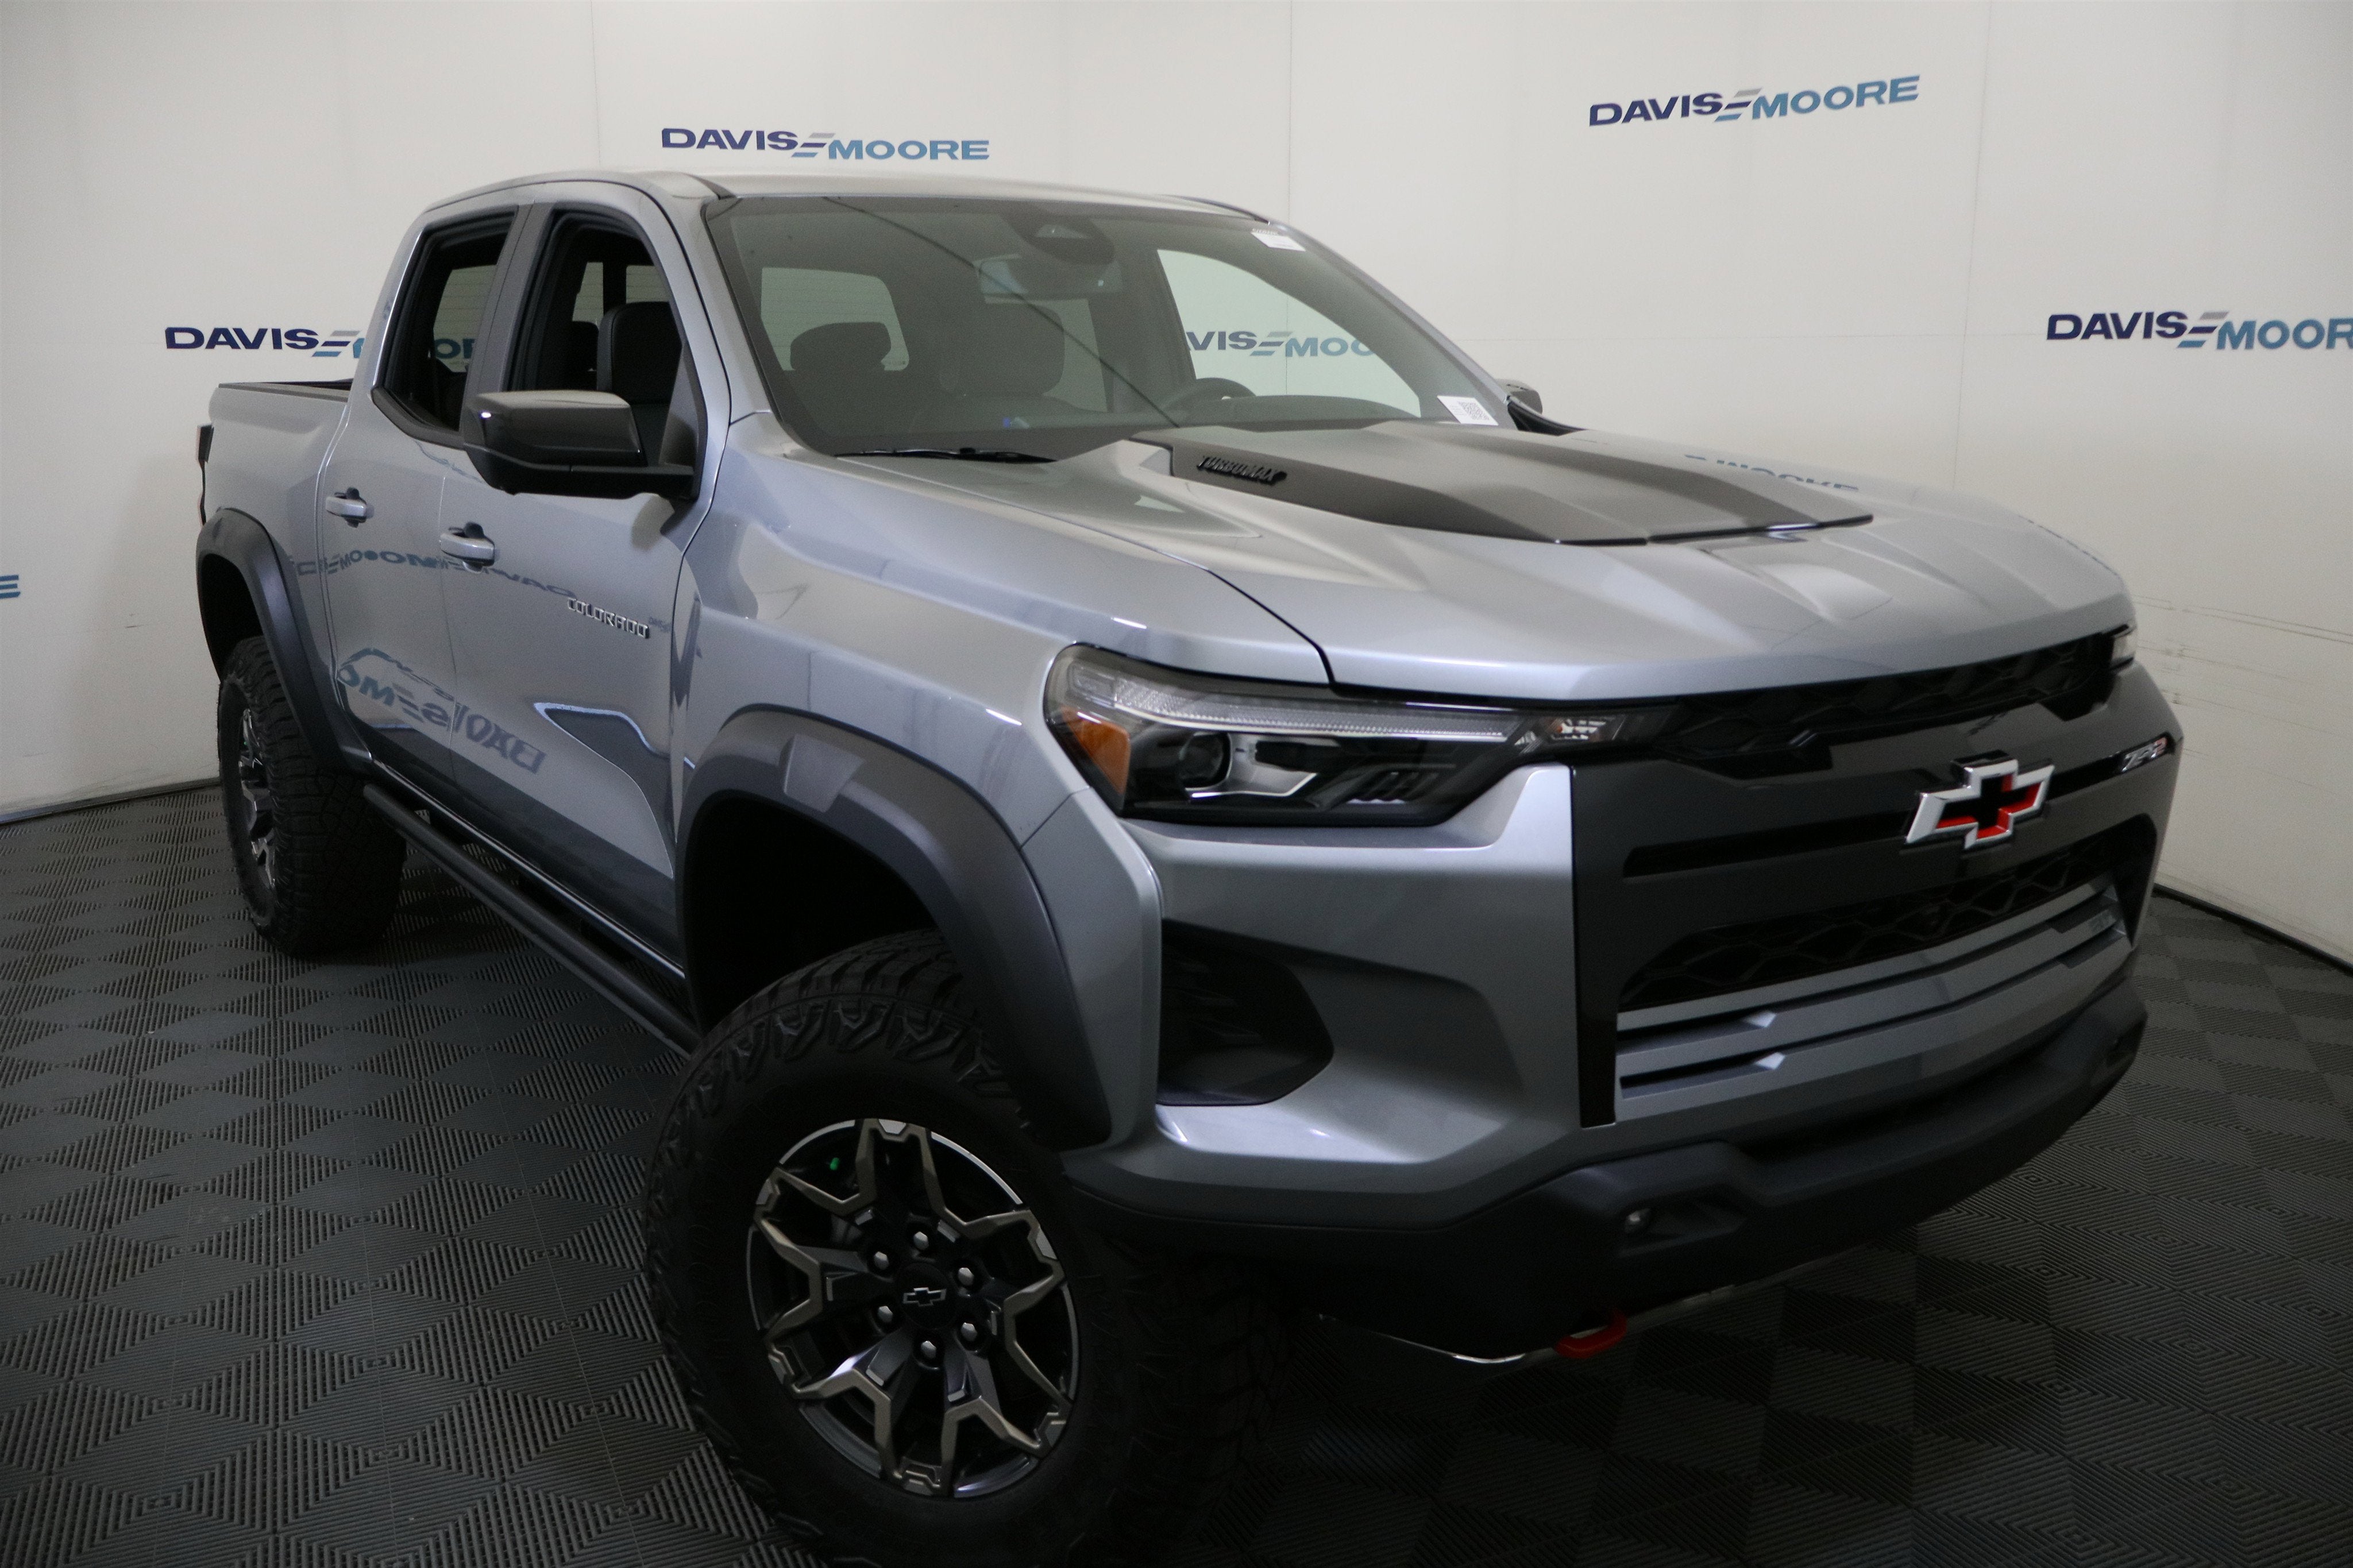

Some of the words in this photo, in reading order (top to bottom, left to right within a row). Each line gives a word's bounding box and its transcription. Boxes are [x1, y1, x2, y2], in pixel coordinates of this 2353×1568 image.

[1589, 92, 1726, 126] DAVIS
[1752, 75, 1920, 119] MOORE
[661, 128, 799, 150] DAVIS
[828, 139, 990, 160] MOORE
[165, 327, 320, 350] DAVIS
[1186, 331, 1257, 351] VIS
[1285, 337, 1376, 357] MOO
[2046, 311, 2188, 340] DAVIS
[2216, 317, 2353, 350] MOOR
[568, 597, 650, 639] COLORADO
